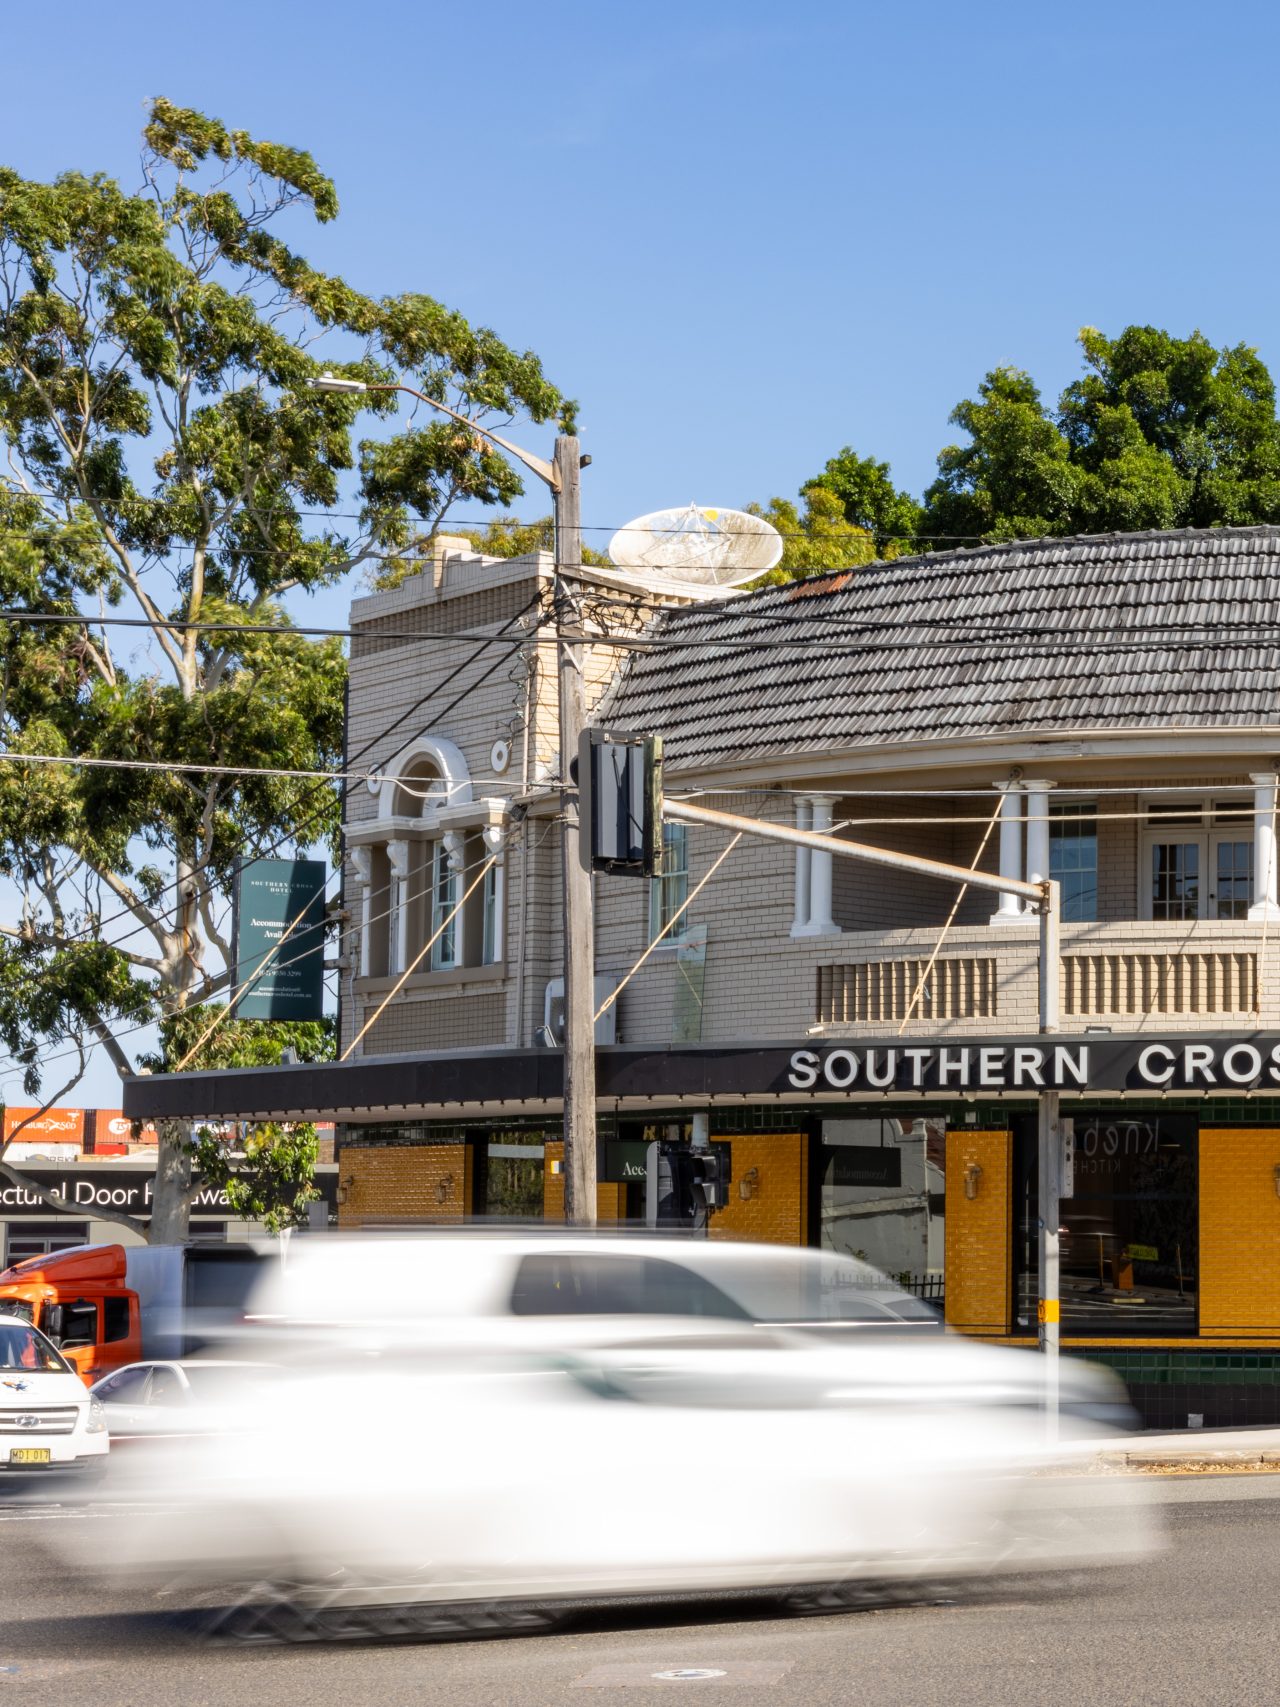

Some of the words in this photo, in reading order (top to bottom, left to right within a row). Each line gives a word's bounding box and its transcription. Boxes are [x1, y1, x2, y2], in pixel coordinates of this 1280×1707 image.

[250, 918, 312, 929] Accommodtion
[788, 1046, 1090, 1088] SOUTHERN
[75, 1182, 139, 1205] Door
